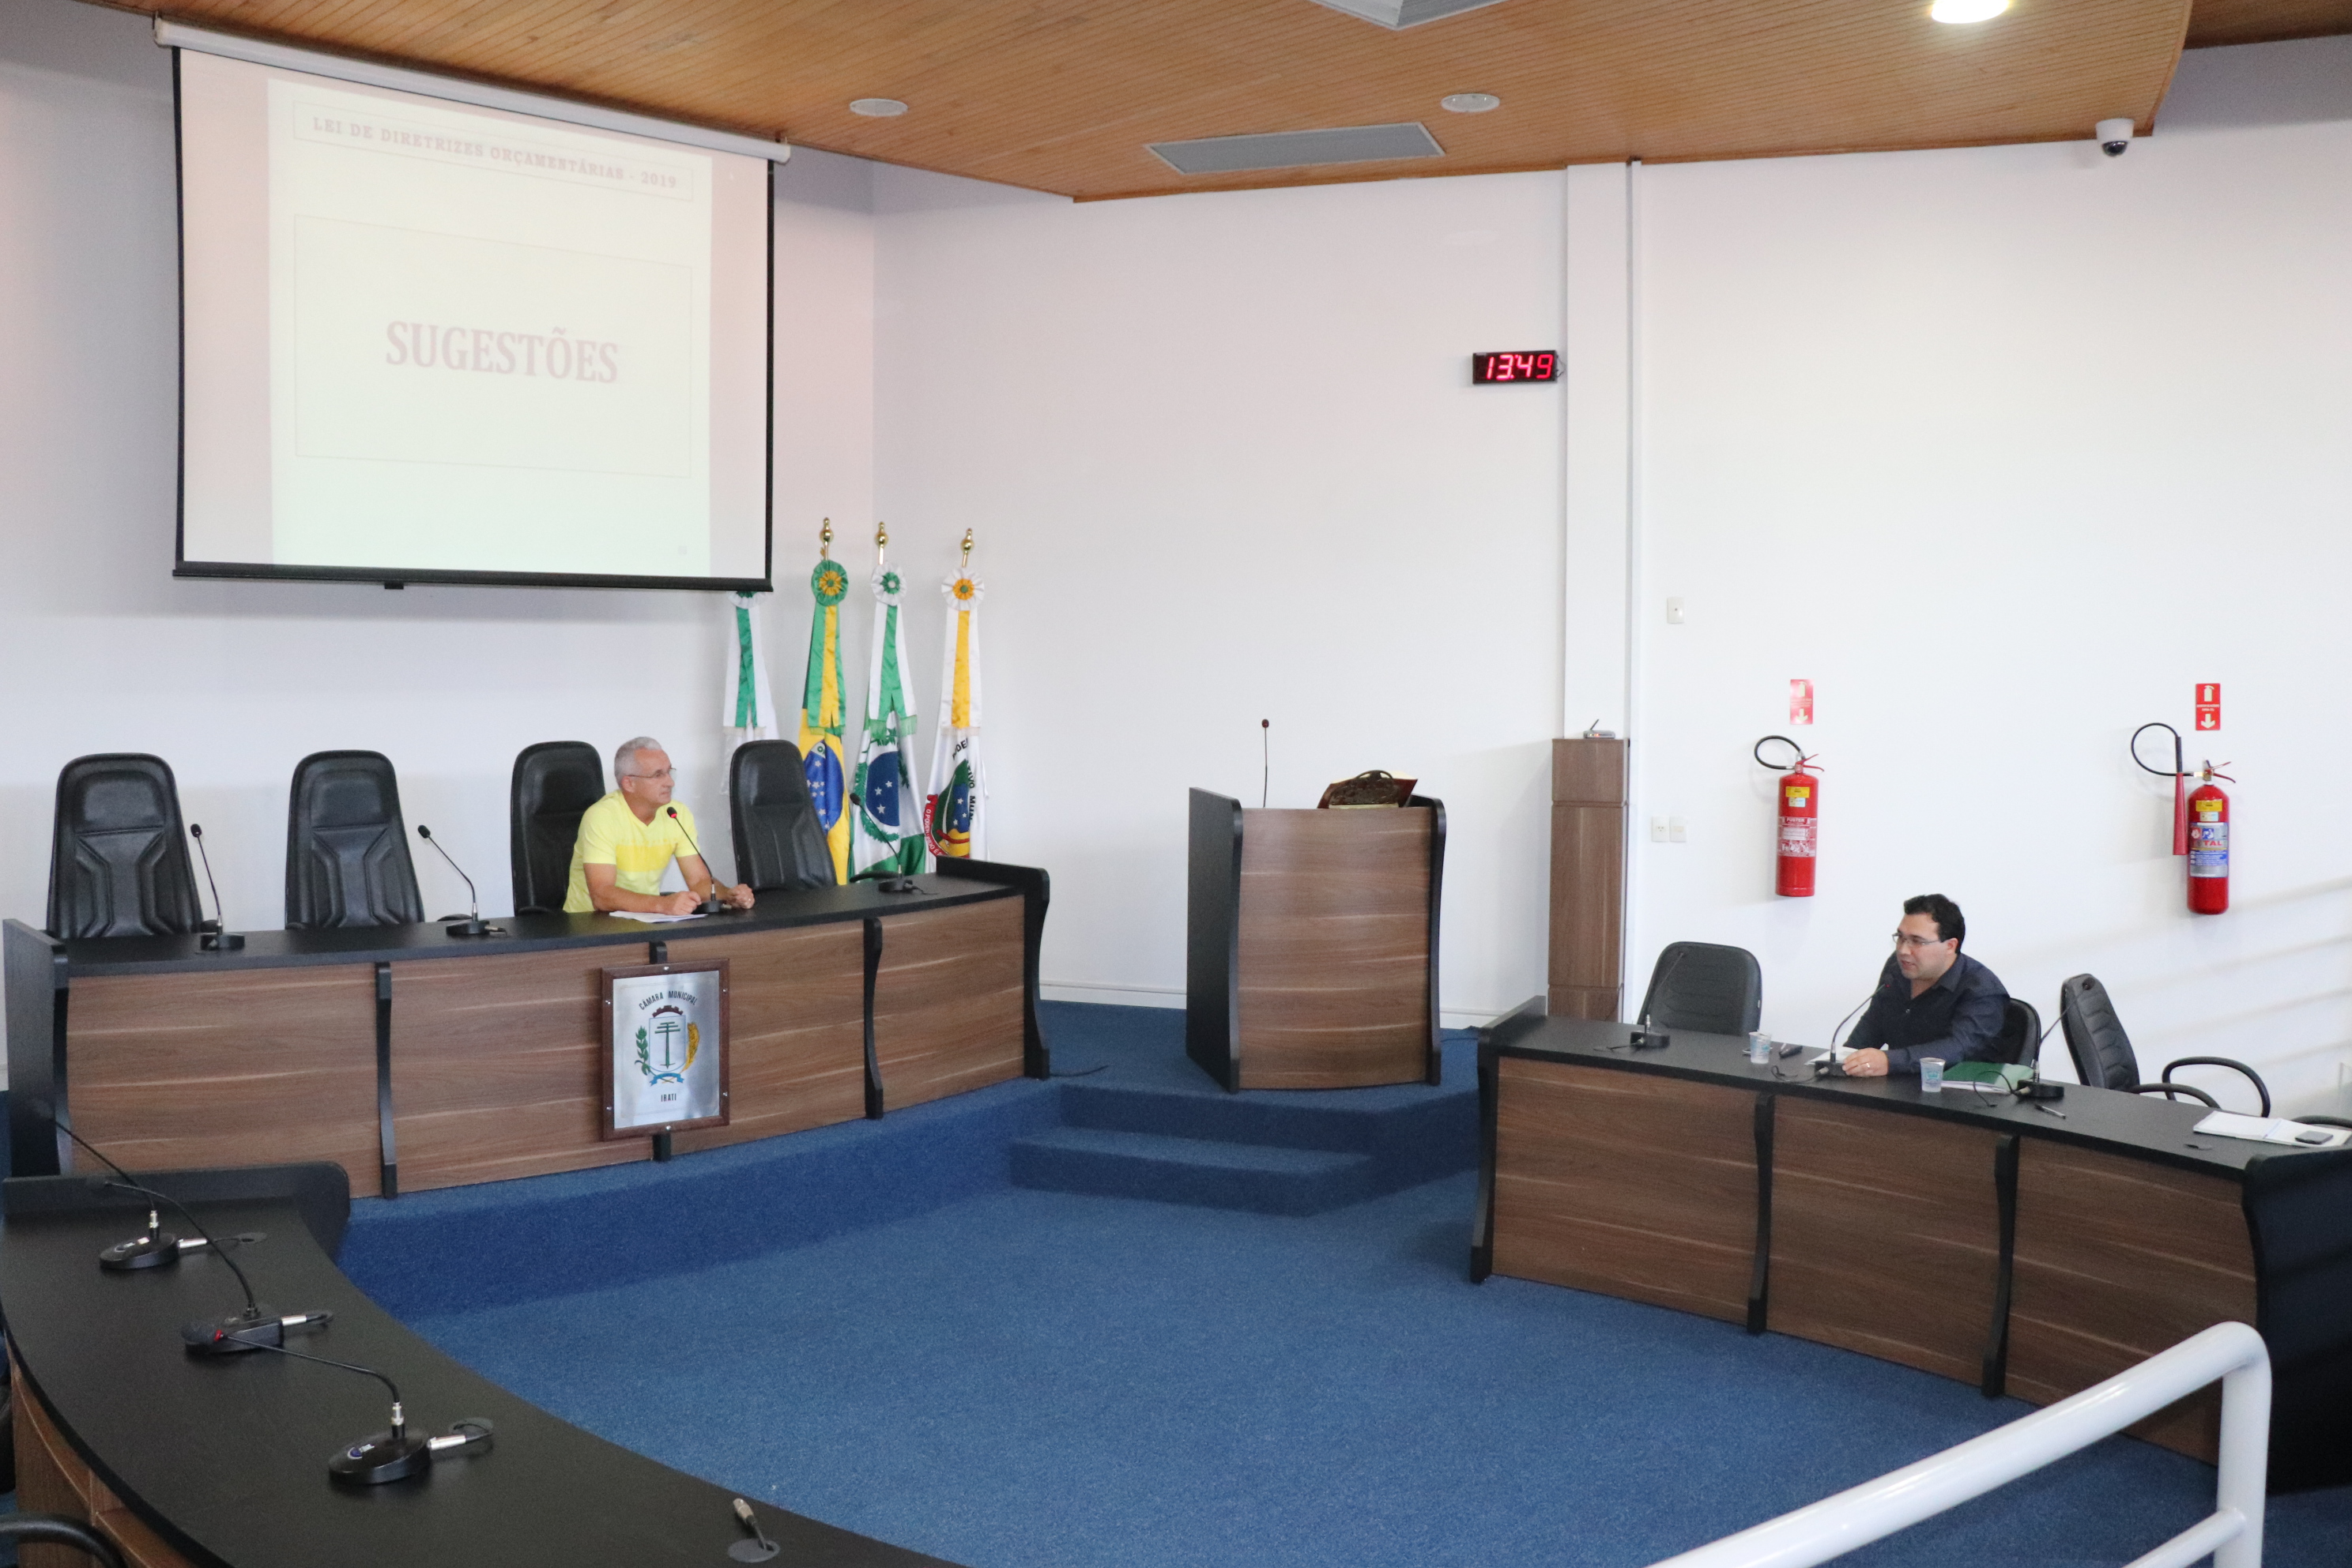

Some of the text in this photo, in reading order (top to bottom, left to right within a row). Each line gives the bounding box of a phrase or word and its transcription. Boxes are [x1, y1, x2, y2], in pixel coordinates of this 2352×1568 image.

[313, 118, 342, 135] LEI
[350, 123, 372, 138] DE
[380, 128, 484, 157] DIRETRIZES
[641, 171, 677, 189] 2019
[386, 319, 619, 383] SUGESTÕES
[668, 990, 698, 1006] MUNICIPAL
[661, 1093, 677, 1102] IRATI
